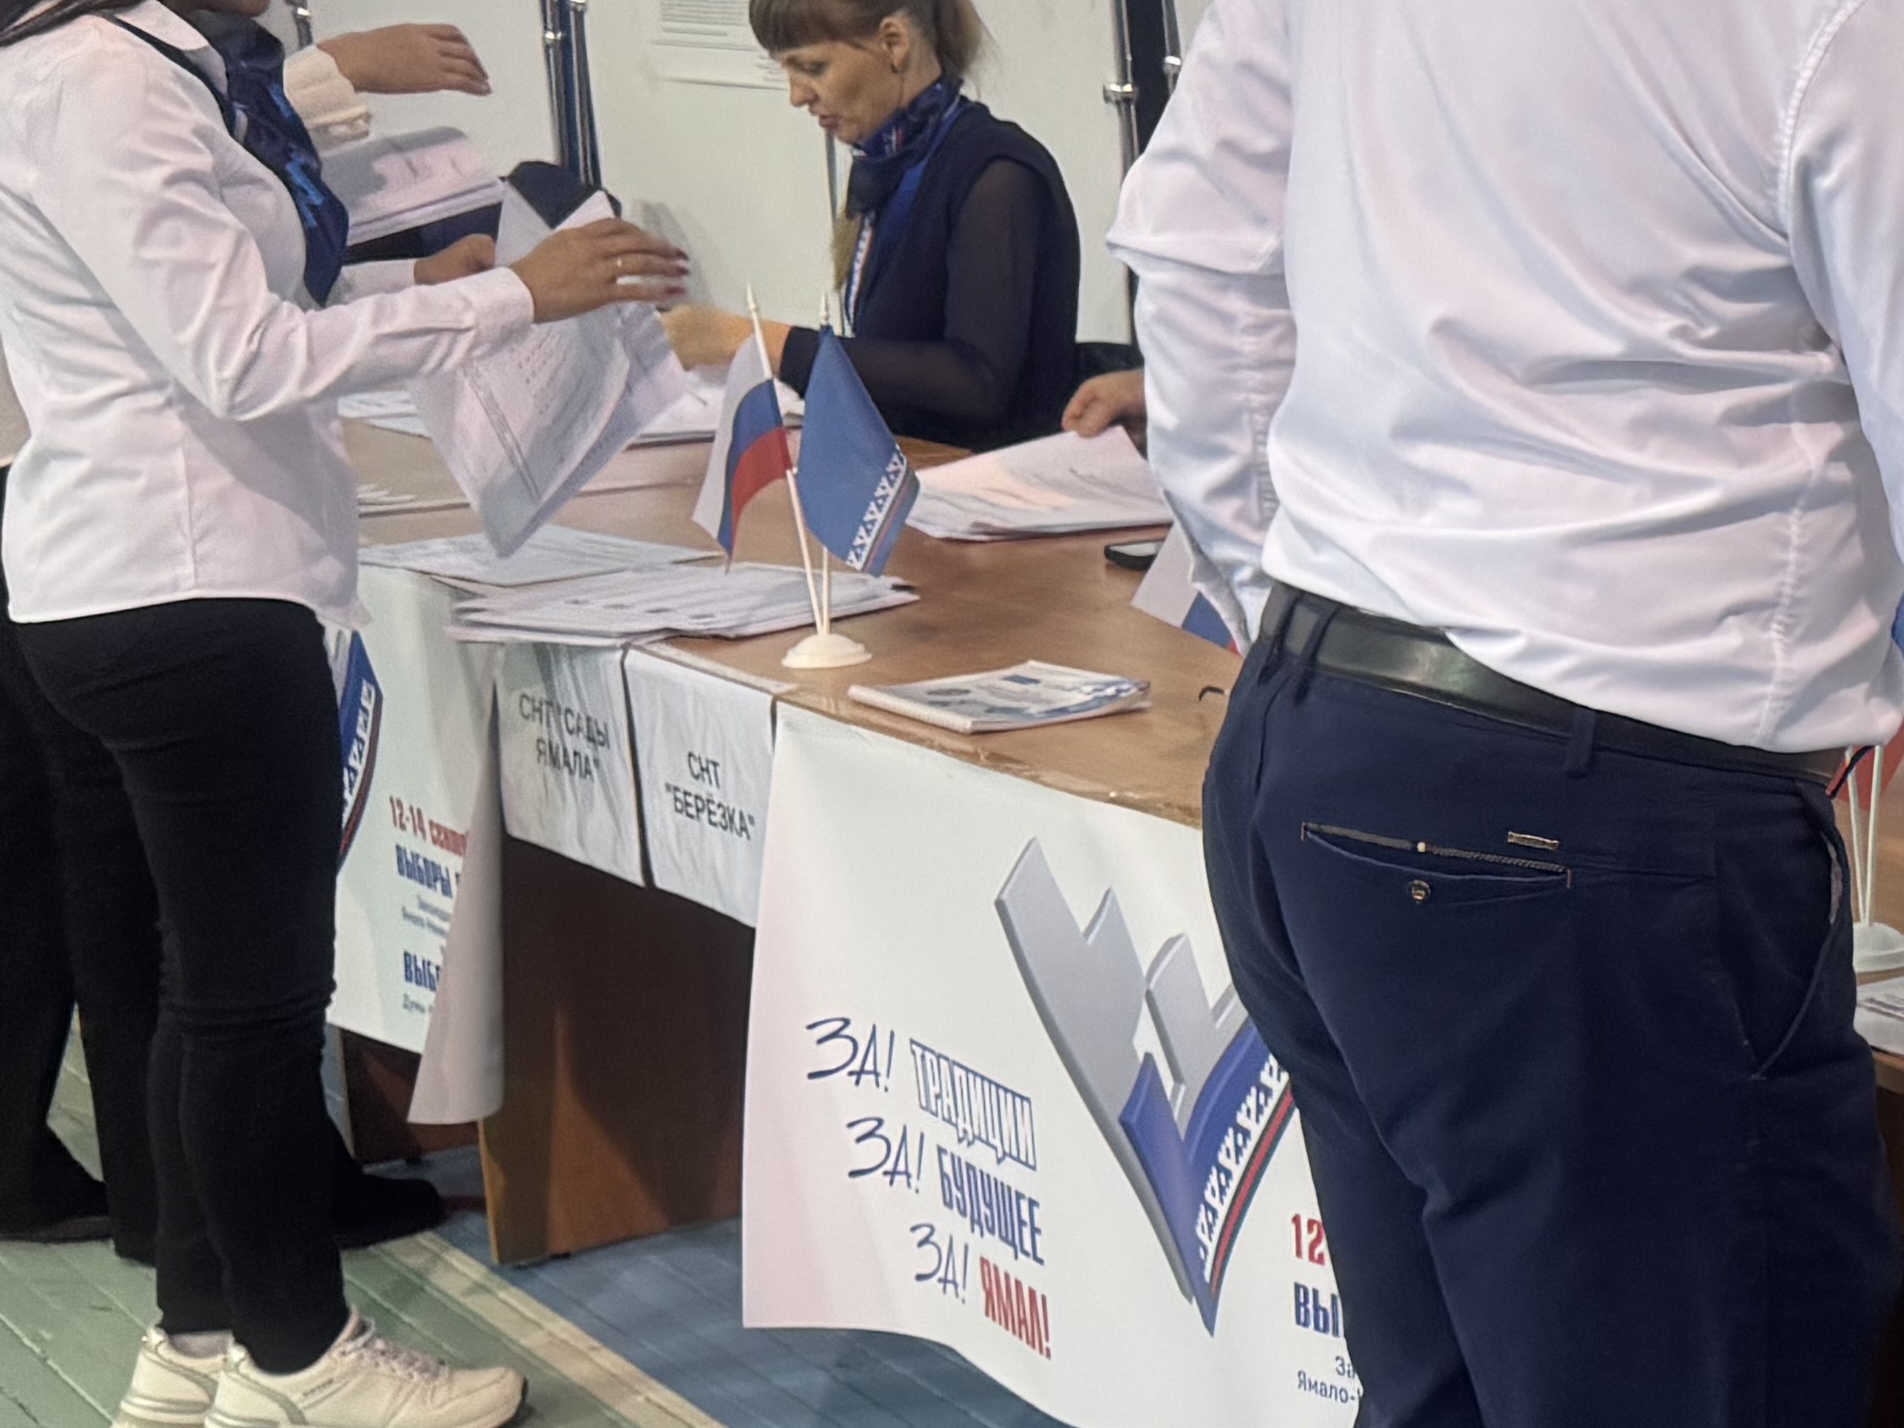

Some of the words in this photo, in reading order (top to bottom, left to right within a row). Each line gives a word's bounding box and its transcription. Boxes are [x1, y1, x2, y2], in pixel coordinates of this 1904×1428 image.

[519, 692, 554, 727] СНТ
[665, 782, 756, 841] "БЕРЁЗКА"
[687, 751, 721, 790] СНТ
[806, 1017, 895, 1092] ЗА!
[909, 1038, 1037, 1171] ТРАДИЦИИ
[846, 1117, 925, 1194] ЗА!
[936, 1144, 1046, 1266] БУДУЩЕЕ
[909, 1222, 969, 1304] ЗА!
[980, 1255, 1052, 1360] ЯМАЛ!
